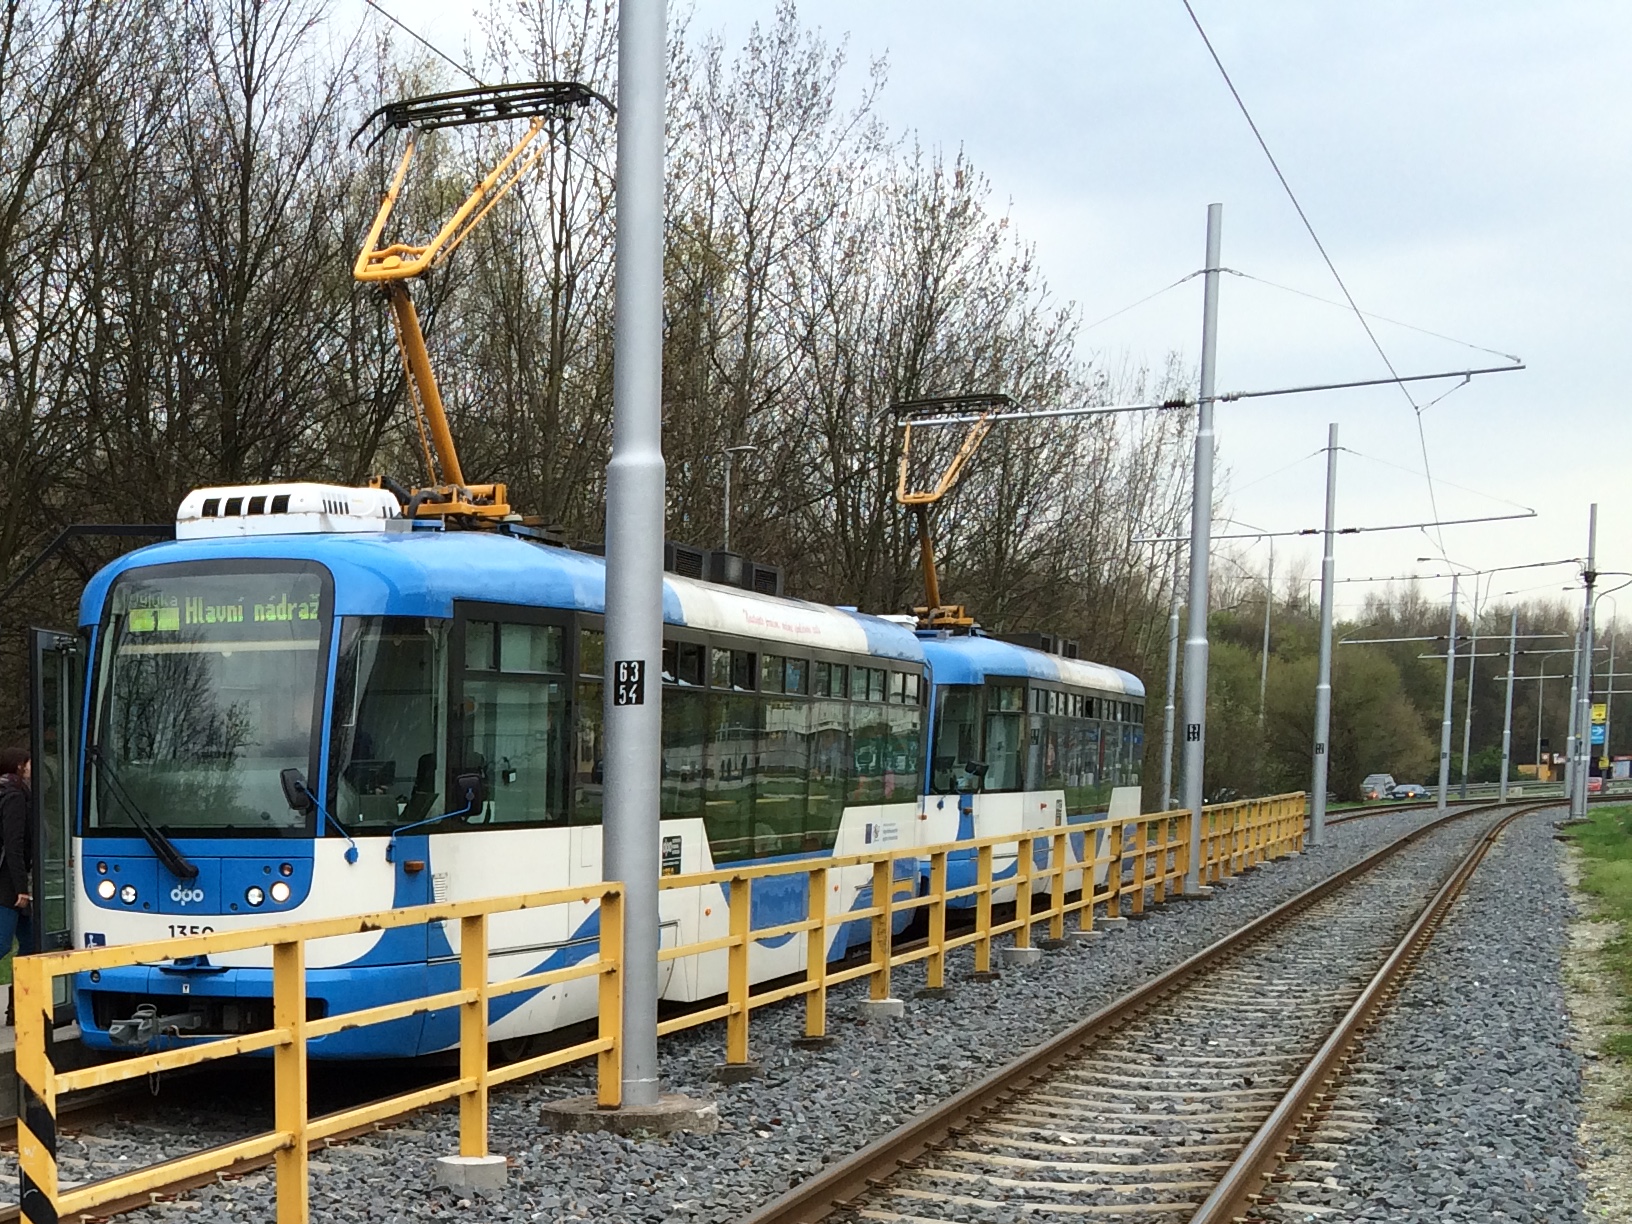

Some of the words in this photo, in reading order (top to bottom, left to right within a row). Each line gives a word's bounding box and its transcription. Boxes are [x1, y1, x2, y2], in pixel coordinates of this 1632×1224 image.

[185, 596, 243, 624] Hlavní
[619, 661, 639, 682] 63
[618, 683, 638, 704] 54
[170, 884, 204, 906] dpo
